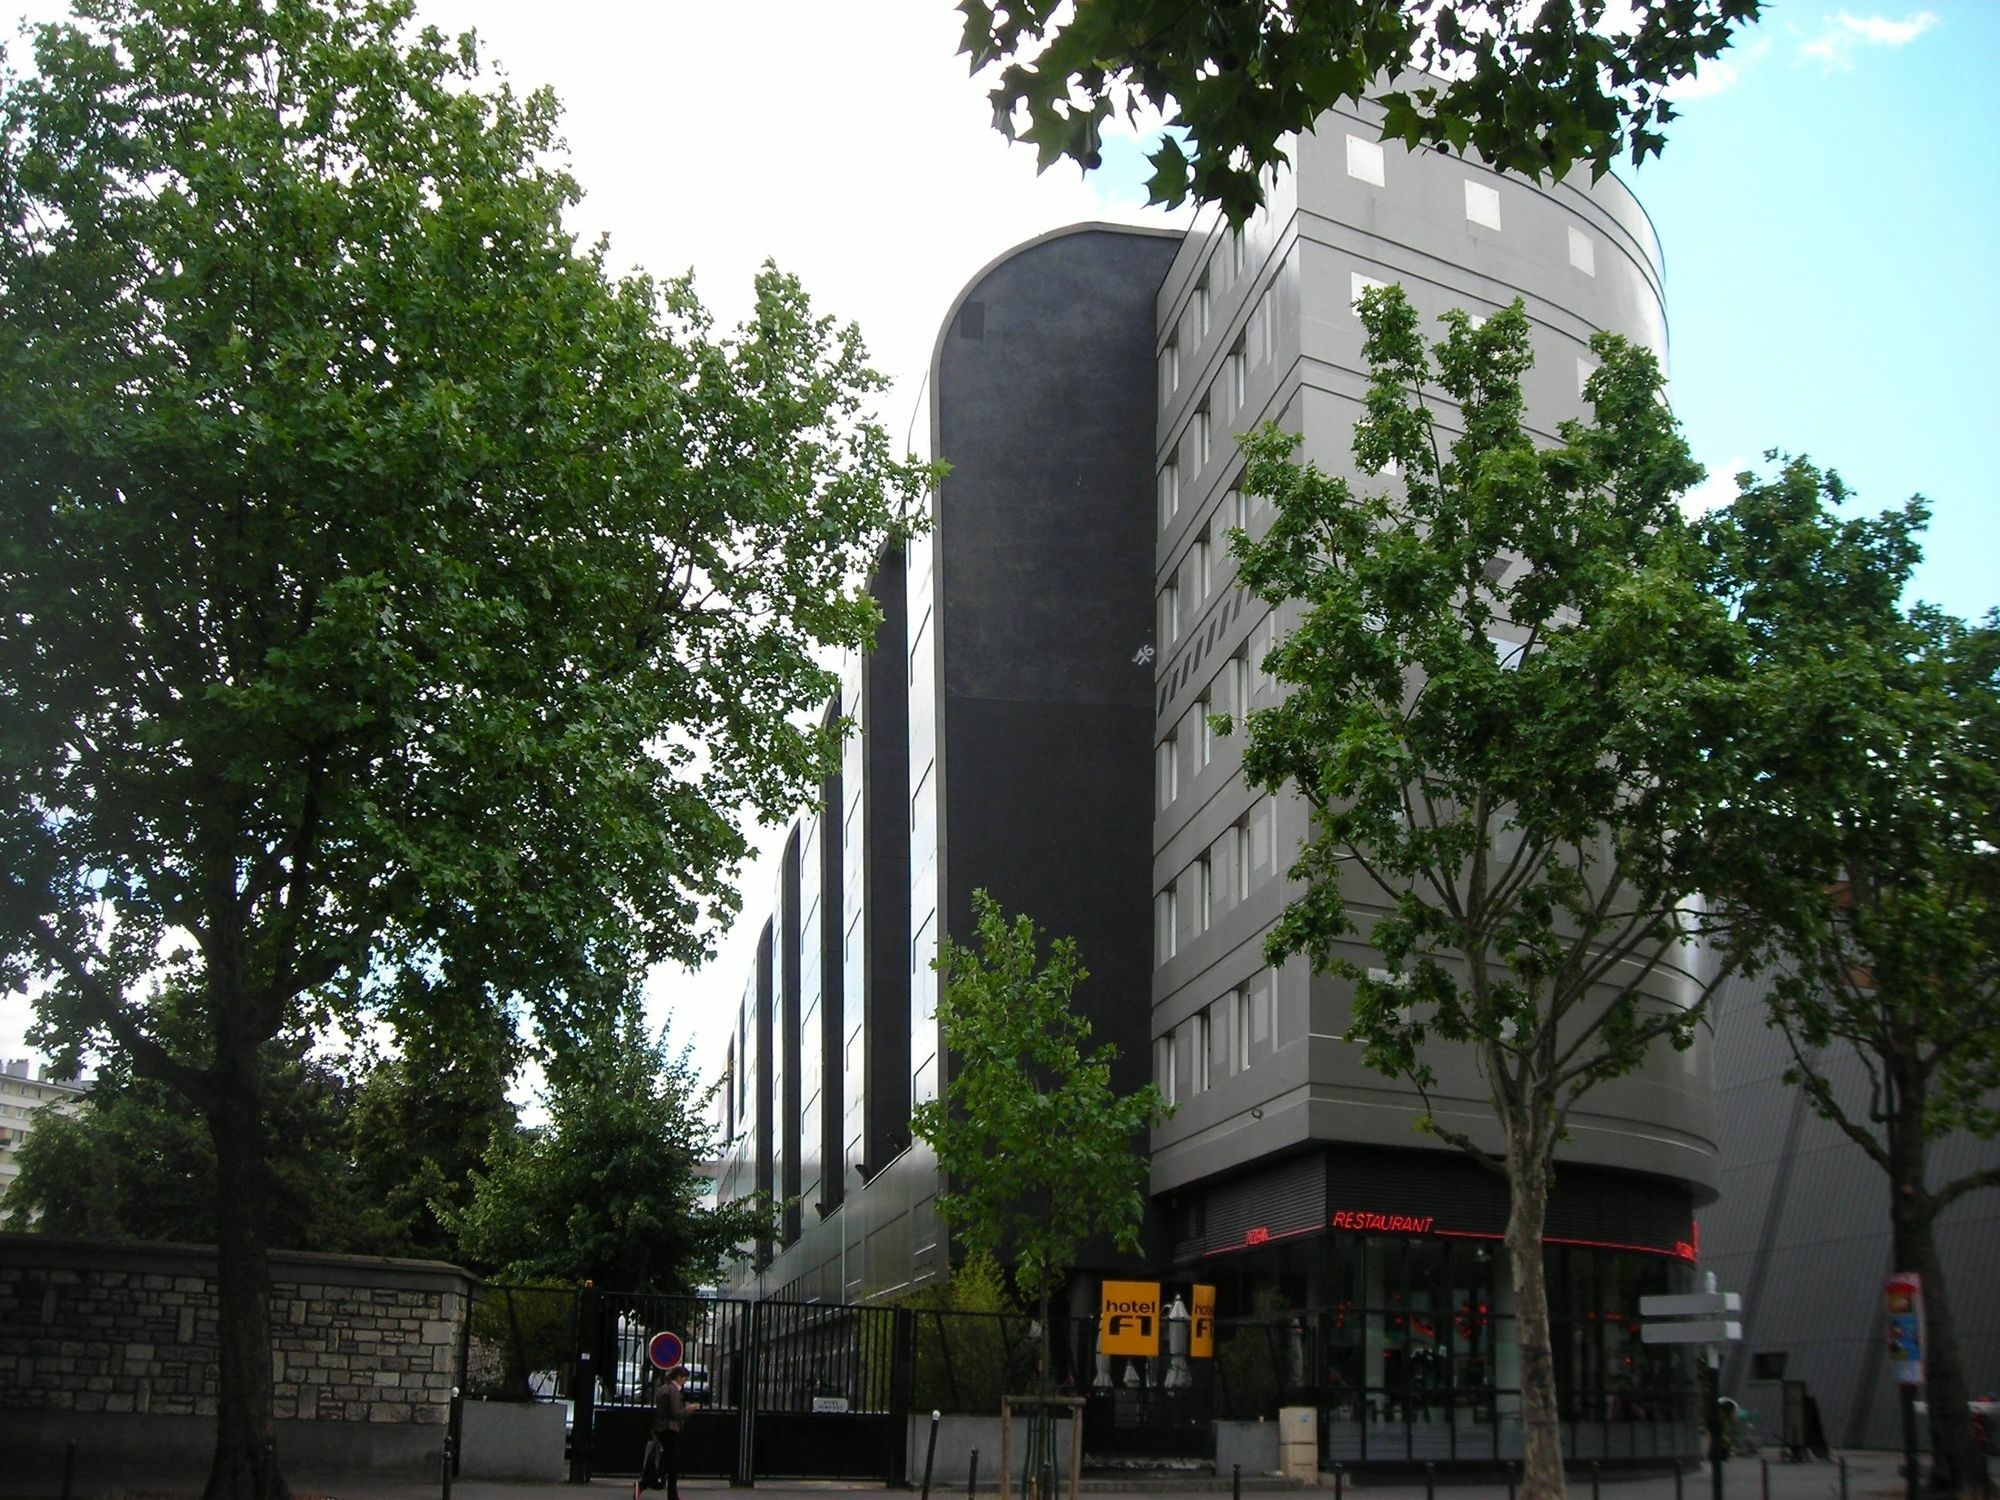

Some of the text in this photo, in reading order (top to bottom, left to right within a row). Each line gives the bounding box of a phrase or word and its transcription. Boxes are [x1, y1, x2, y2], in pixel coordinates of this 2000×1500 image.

[1332, 1211, 1434, 1233] RESTAURANT
[1105, 1300, 1156, 1314] hotel
[1108, 1315, 1152, 1337] F1
